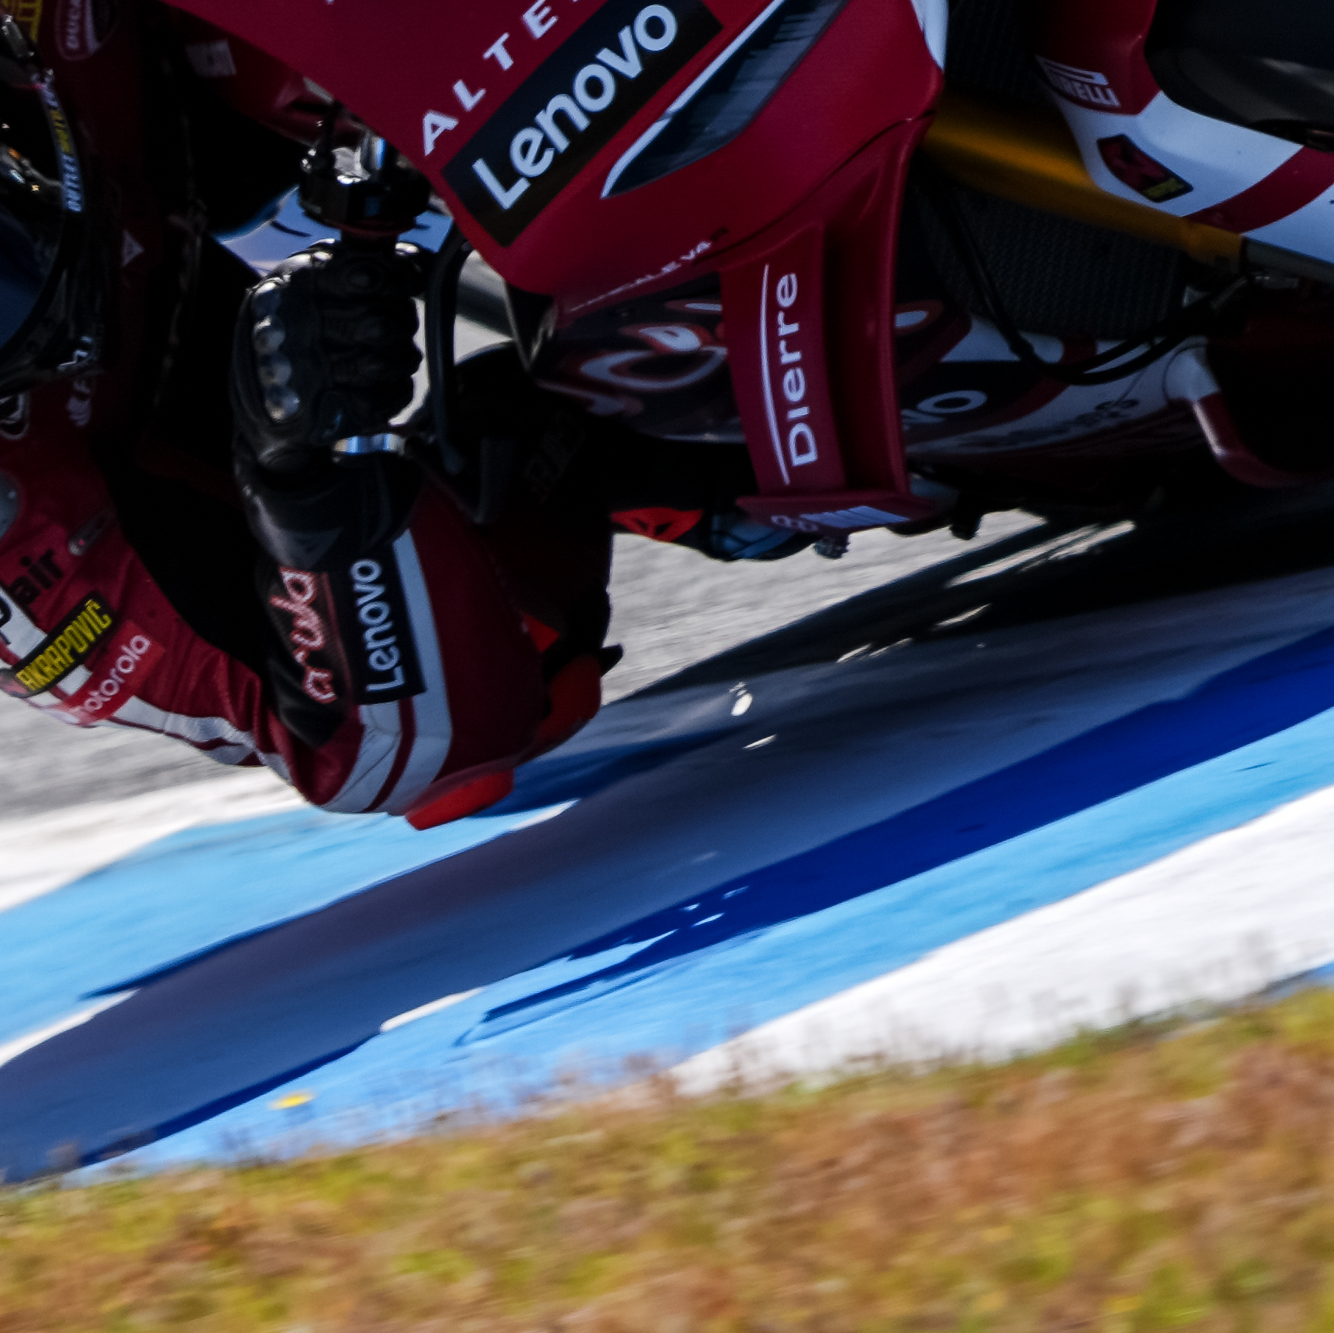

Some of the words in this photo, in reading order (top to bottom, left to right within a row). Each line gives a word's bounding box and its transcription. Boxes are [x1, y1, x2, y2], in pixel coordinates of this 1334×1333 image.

[472, 4, 678, 210] Lenovo
[776, 272, 819, 466] Dierre
[16, 598, 112, 692] AKRAPOVIČ
[350, 559, 405, 693] Lenovo
